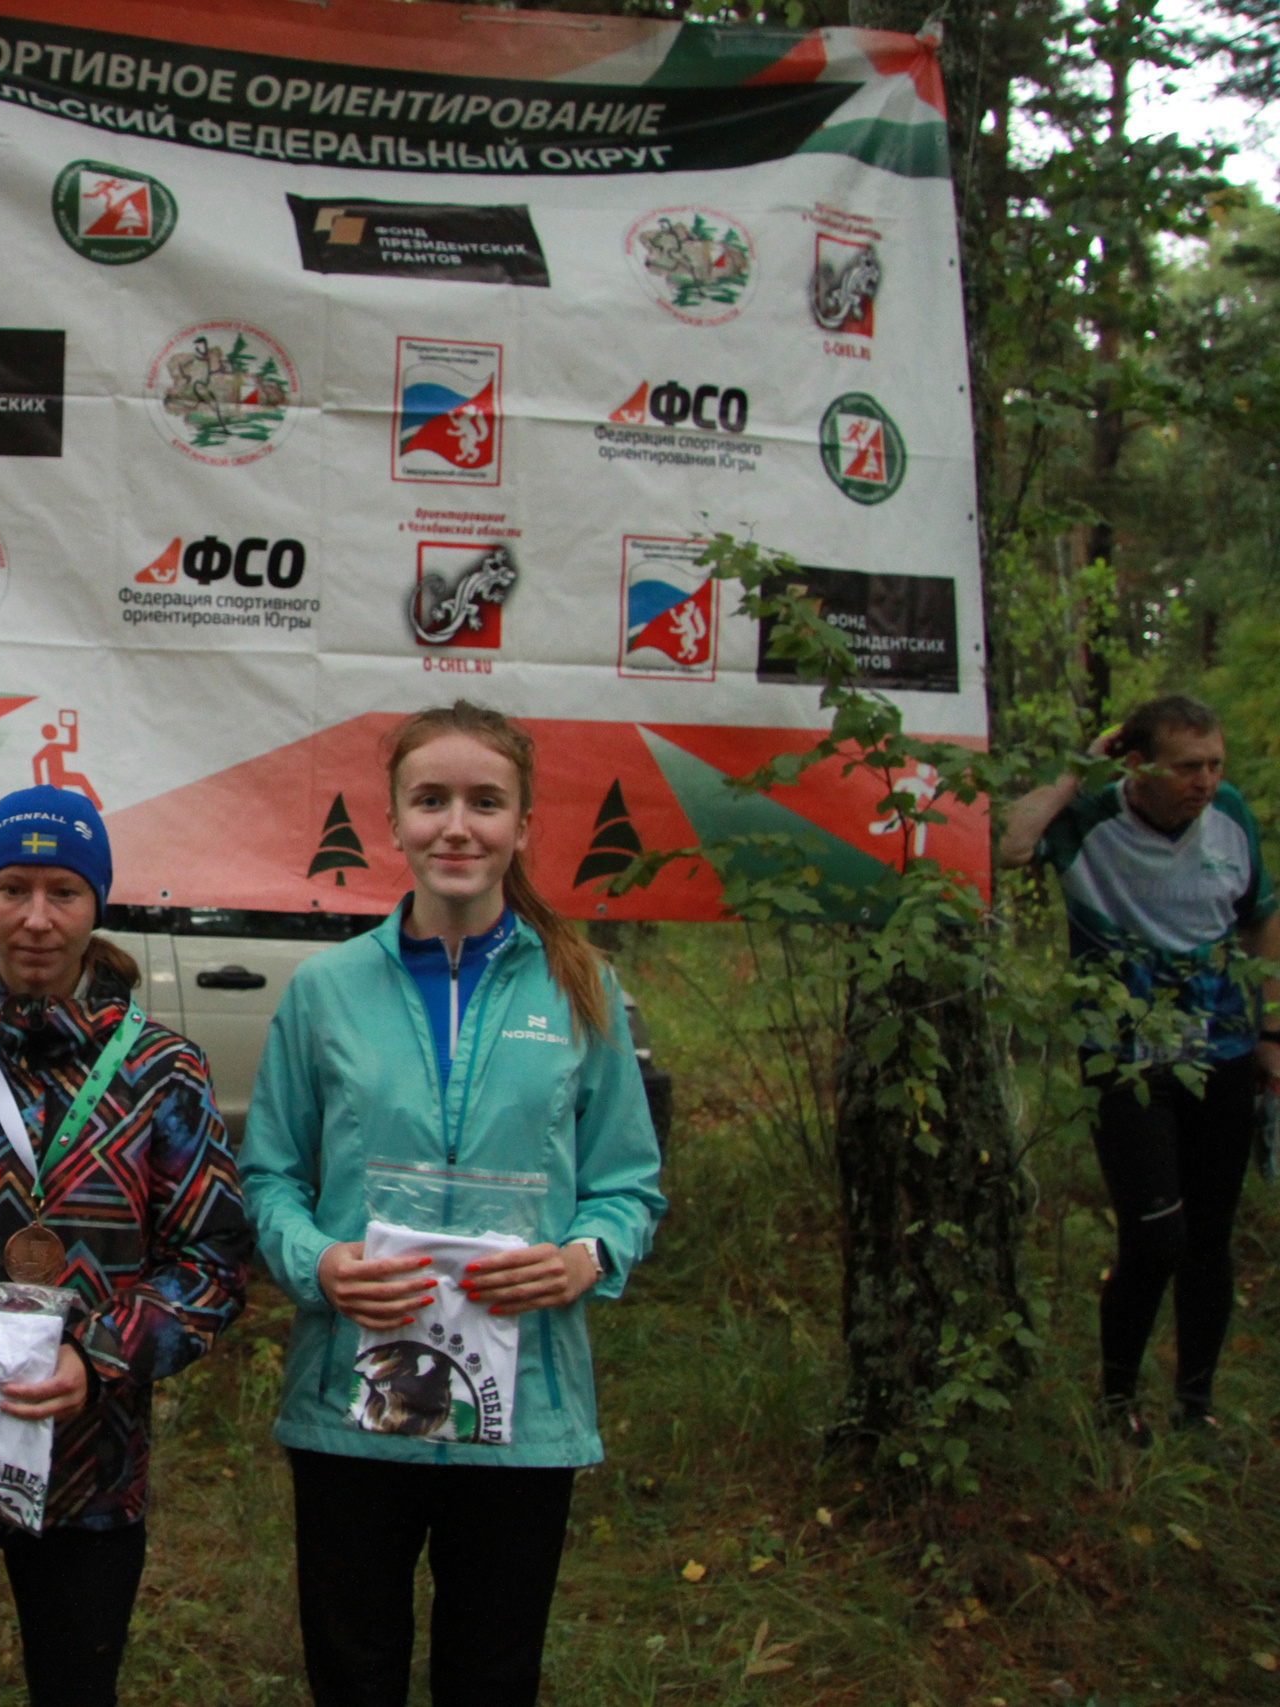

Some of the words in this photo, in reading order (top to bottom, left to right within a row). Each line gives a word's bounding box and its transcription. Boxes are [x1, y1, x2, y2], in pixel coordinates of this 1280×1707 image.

[246, 75, 666, 136] ОРИЕНТИРОВАНИЕ
[188, 117, 530, 170] ФЕДЕРАЛЬНЫЙ
[539, 145, 673, 170] ОКРУГ
[374, 226, 428, 239] ФОНД
[378, 237, 526, 256] ПРЕЗИДЕНТСКИХ
[381, 251, 463, 266] ГРАНТОВ
[649, 380, 748, 433] ФСО
[594, 424, 676, 446] Федерация
[679, 436, 763, 456] спортивного
[598, 445, 716, 467] ориентирования
[182, 534, 306, 589] ФСО
[118, 586, 212, 608] Федерация
[215, 594, 321, 612] спортивного
[122, 608, 261, 628] ориентирования
[264, 611, 312, 632] Югры
[826, 613, 867, 630] ФОНД
[845, 633, 946, 653] ЗИДЕНТСКИХ
[502, 1030, 570, 1046] NORDSKI
